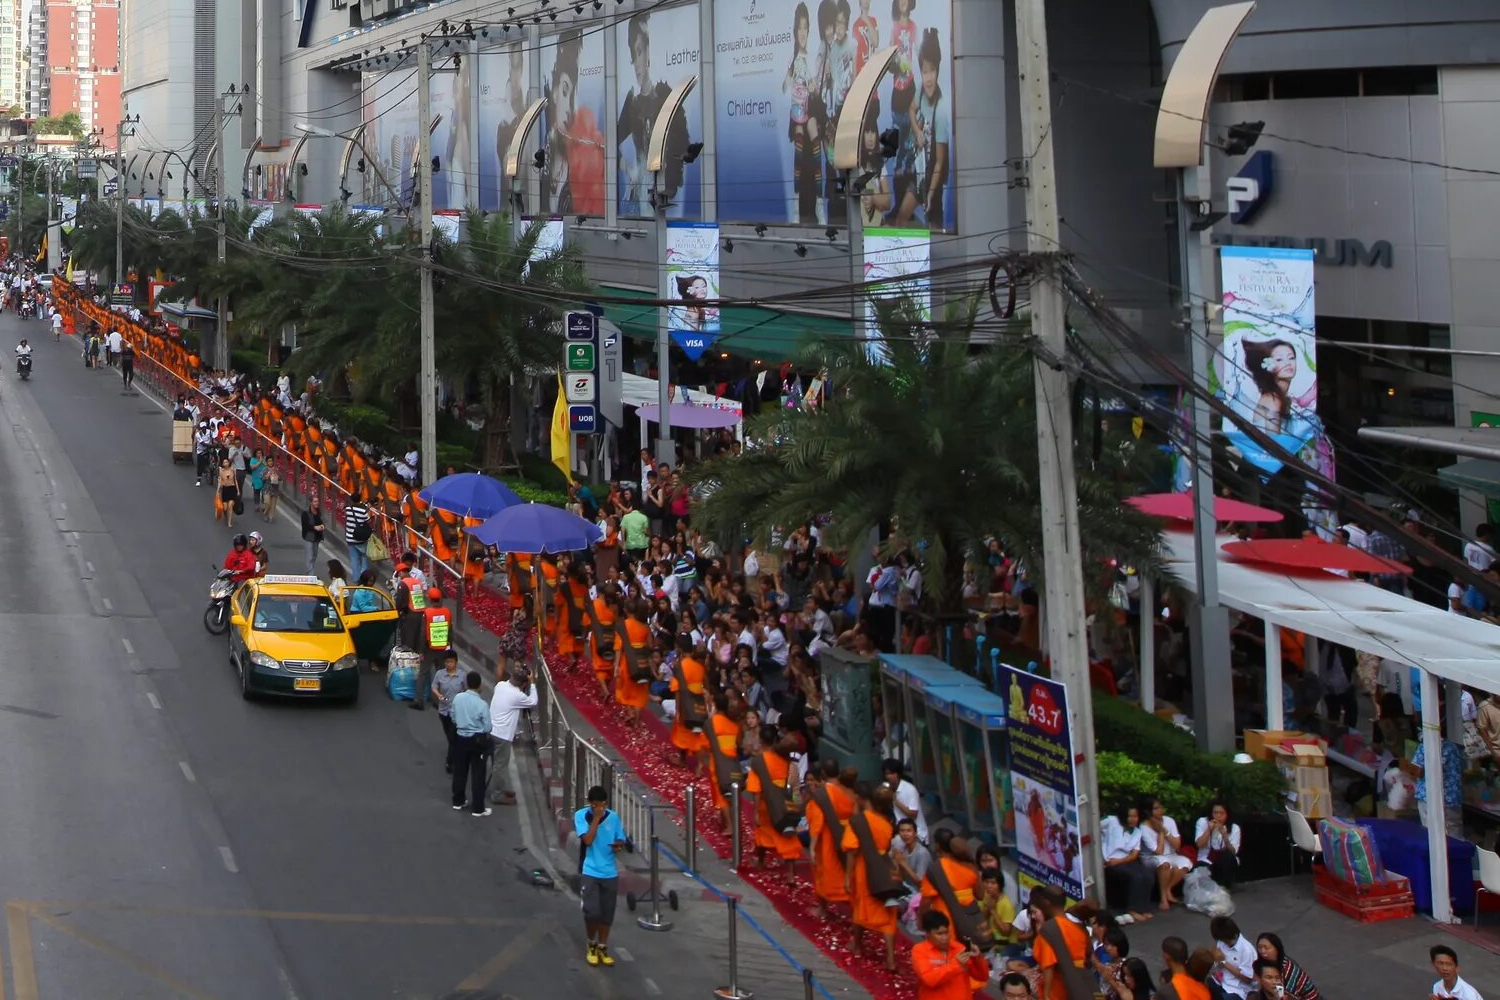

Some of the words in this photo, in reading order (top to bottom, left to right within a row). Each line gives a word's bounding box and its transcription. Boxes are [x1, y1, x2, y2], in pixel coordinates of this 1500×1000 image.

[665, 48, 700, 66] Leather
[727, 99, 772, 117] Children
[1238, 284, 1277, 294] FESTIVAL
[1280, 285, 1300, 294] 2012
[685, 339, 704, 348] VISA
[605, 358, 616, 382] 1
[1028, 702, 1061, 730] 43.7
